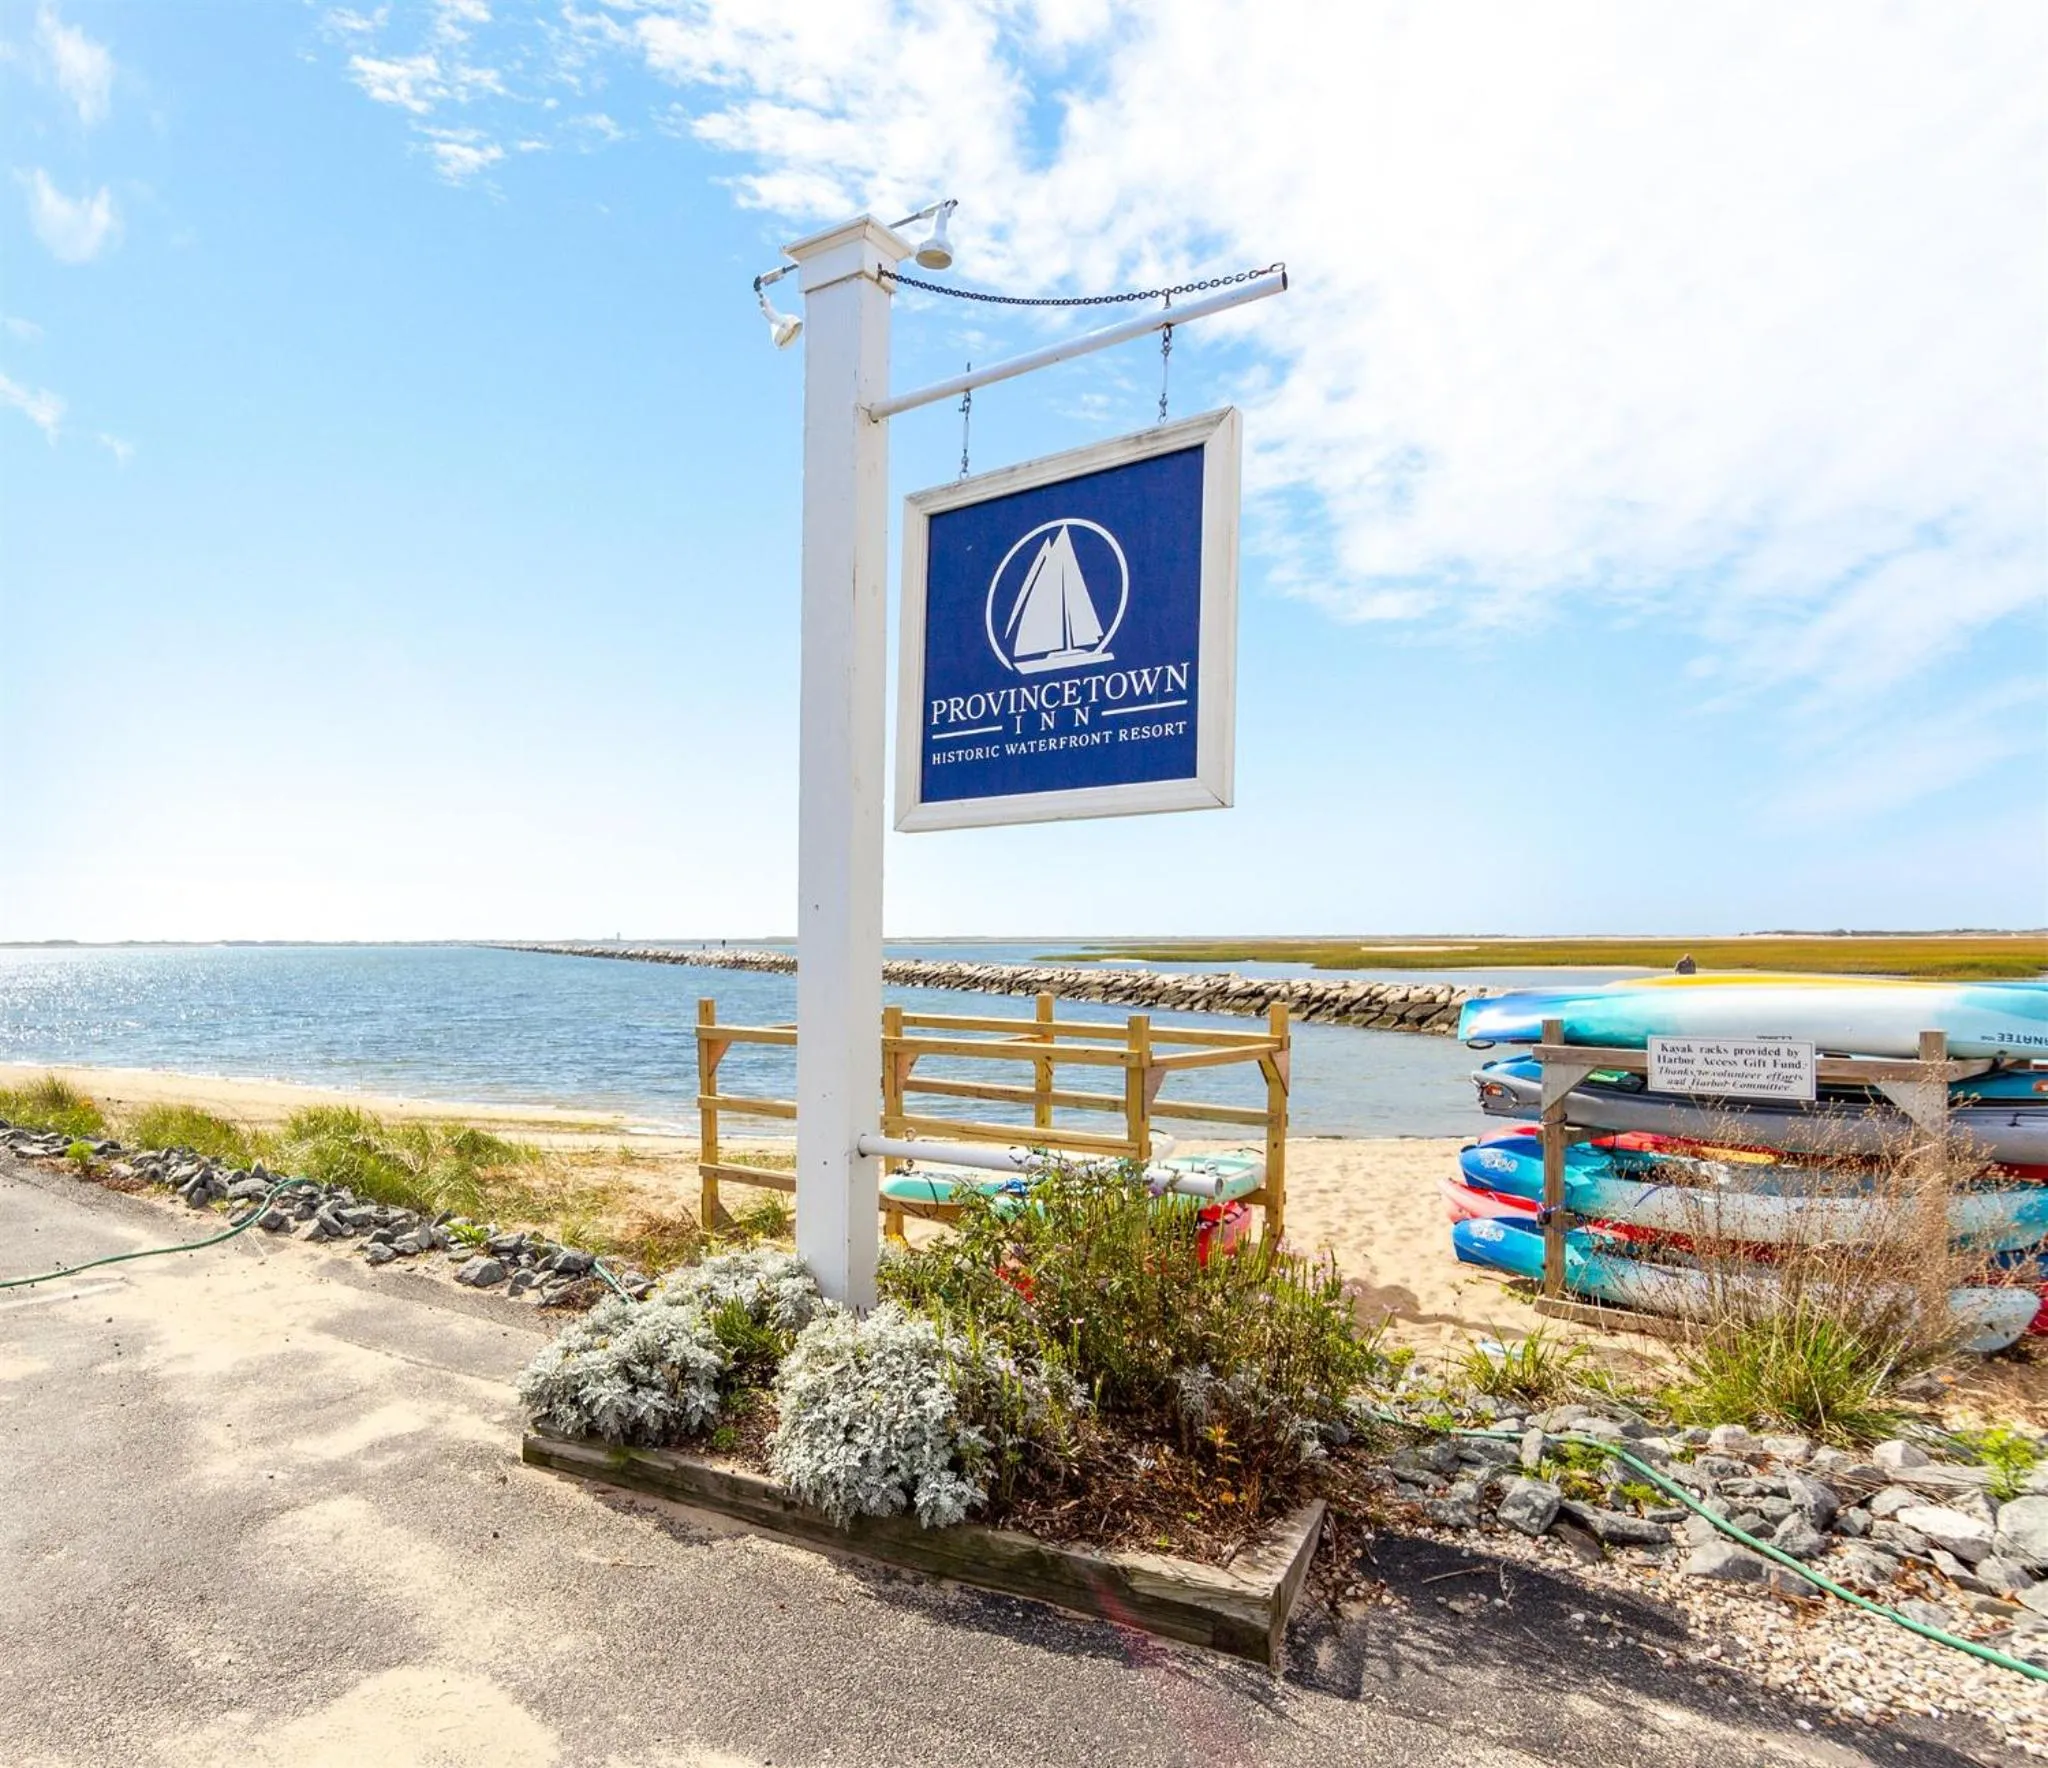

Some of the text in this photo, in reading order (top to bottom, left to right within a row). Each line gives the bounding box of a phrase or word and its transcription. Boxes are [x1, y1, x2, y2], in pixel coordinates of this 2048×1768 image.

[931, 661, 1190, 726] PROVINCETOWN
[931, 720, 1188, 766] HISTORIC WATERFRONT RESORT
[1660, 1043, 1800, 1059] Kayak racks provided by
[1657, 1055, 1696, 1065] Harbor
[1704, 1057, 1738, 1067] Access
[1743, 1058, 1767, 1068] Gift
[1711, 1069, 1763, 1080] volunteer
[1766, 1071, 1803, 1081] efforts
